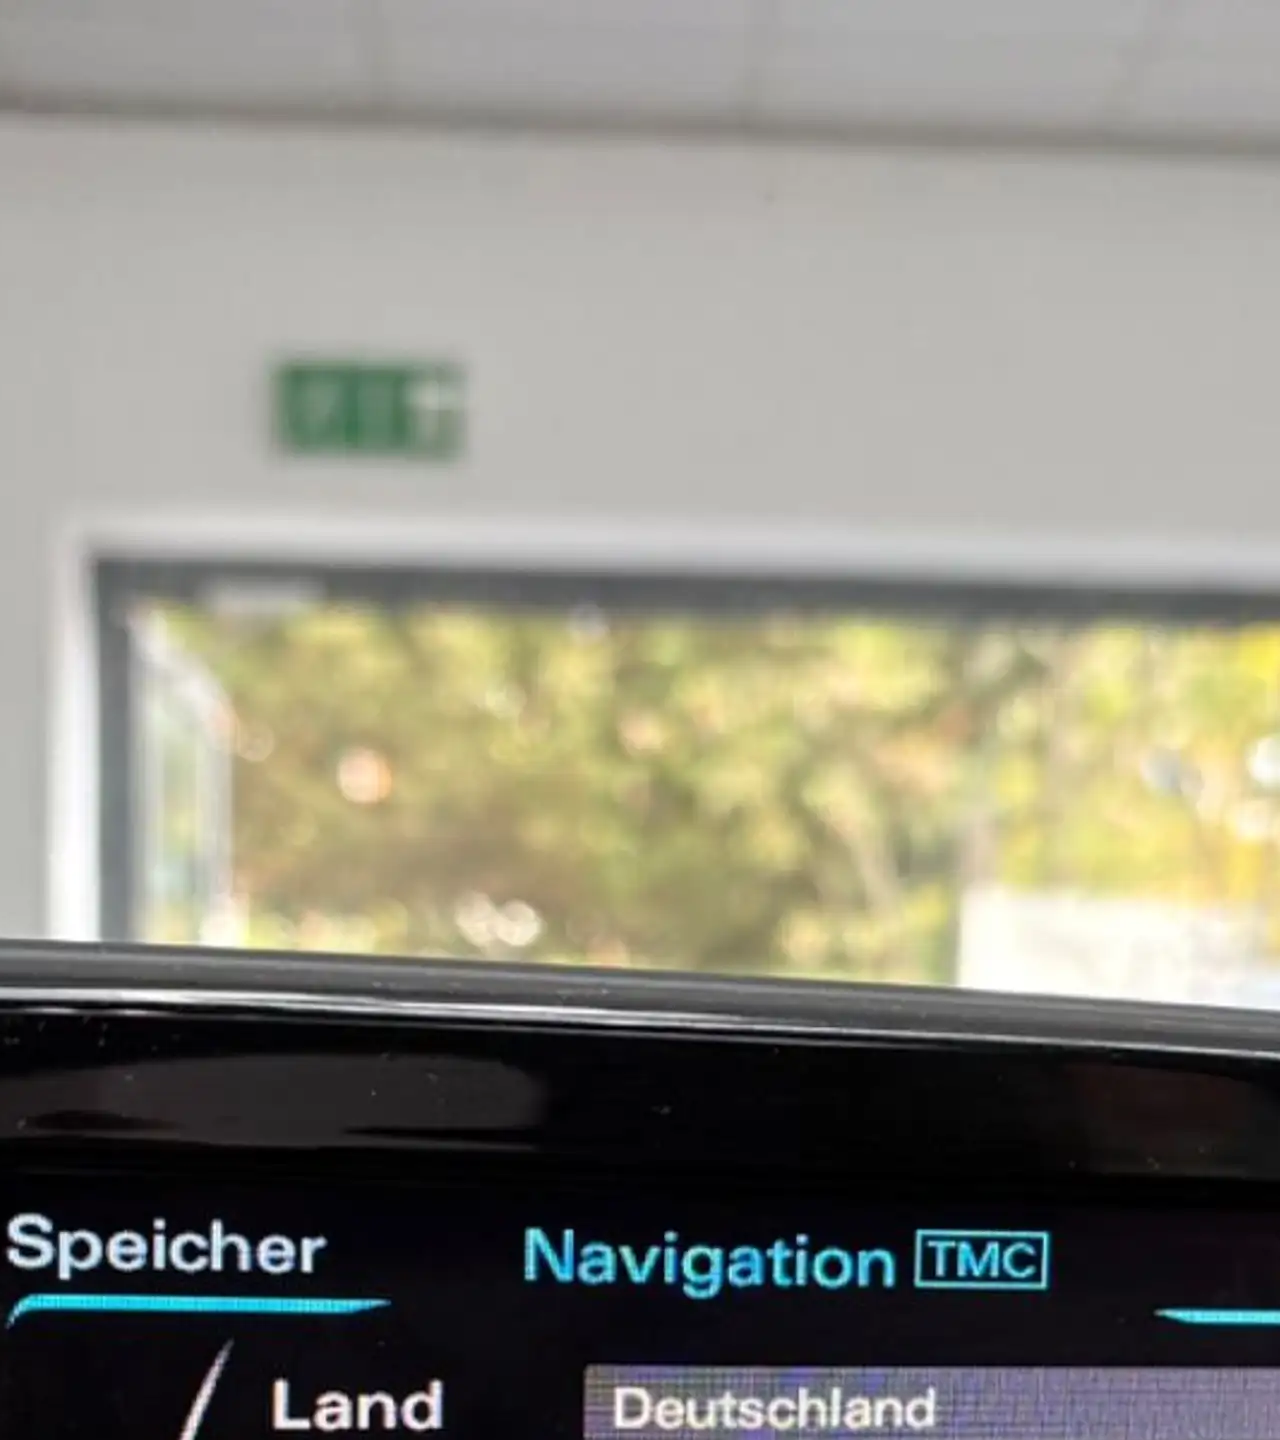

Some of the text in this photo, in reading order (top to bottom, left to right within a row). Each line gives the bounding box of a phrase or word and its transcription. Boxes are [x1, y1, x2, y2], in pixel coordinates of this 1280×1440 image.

[6, 1213, 327, 1280] Speicher
[522, 1227, 896, 1299] Navigation
[926, 1239, 1038, 1280] TMC
[272, 1379, 443, 1431] Land
[613, 1386, 937, 1431] Deutschland
